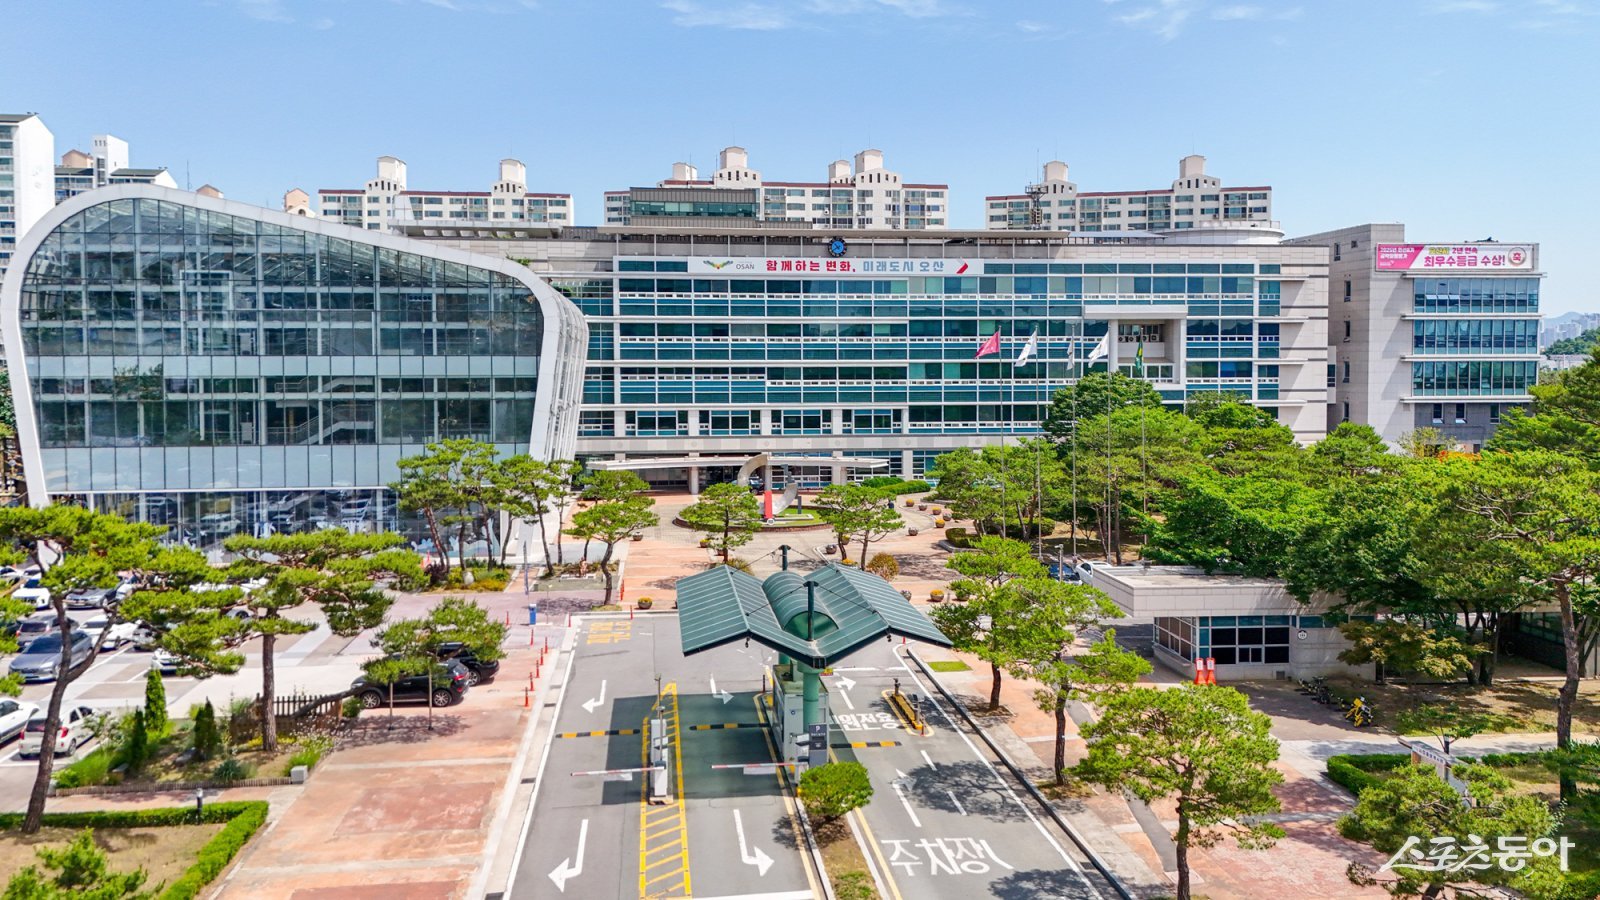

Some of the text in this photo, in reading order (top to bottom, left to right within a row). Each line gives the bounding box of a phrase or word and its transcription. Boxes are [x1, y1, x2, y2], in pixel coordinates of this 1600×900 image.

[766, 260, 945, 273] 함께하는 변화, 미래도시 오산
[1424, 255, 1506, 267] 최우수등급 수상!
[833, 712, 900, 731] 원전용
[880, 837, 990, 876] 주차장
